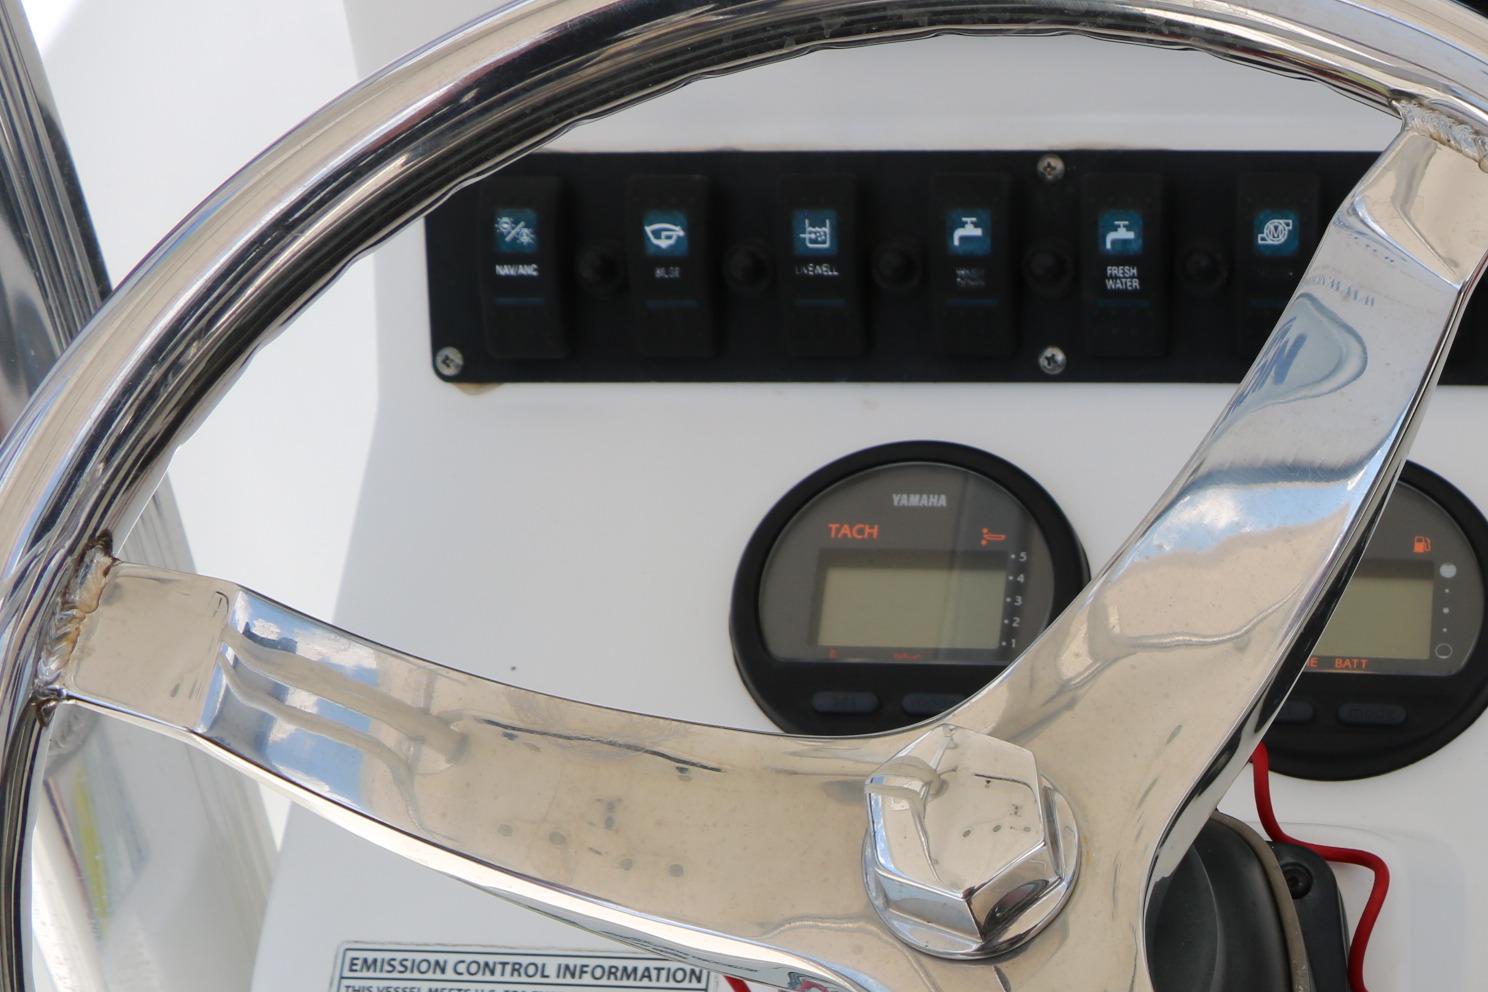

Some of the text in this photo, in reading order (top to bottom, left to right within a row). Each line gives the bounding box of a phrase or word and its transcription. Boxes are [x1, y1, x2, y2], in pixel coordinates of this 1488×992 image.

[496, 264, 539, 276] NAV/ANC
[1107, 266, 1137, 277] FRESH
[1106, 278, 1140, 290] WATER
[892, 494, 947, 507] YAMAHA
[828, 523, 880, 540] TACH
[1019, 551, 1027, 561] 5
[1016, 573, 1024, 583] 4
[1015, 596, 1022, 606] 3
[1012, 617, 1020, 627] 2
[1010, 639, 1016, 648] 1
[1335, 657, 1368, 669] BATT
[348, 956, 705, 983] EMISSION CONTROL INFORMATION
